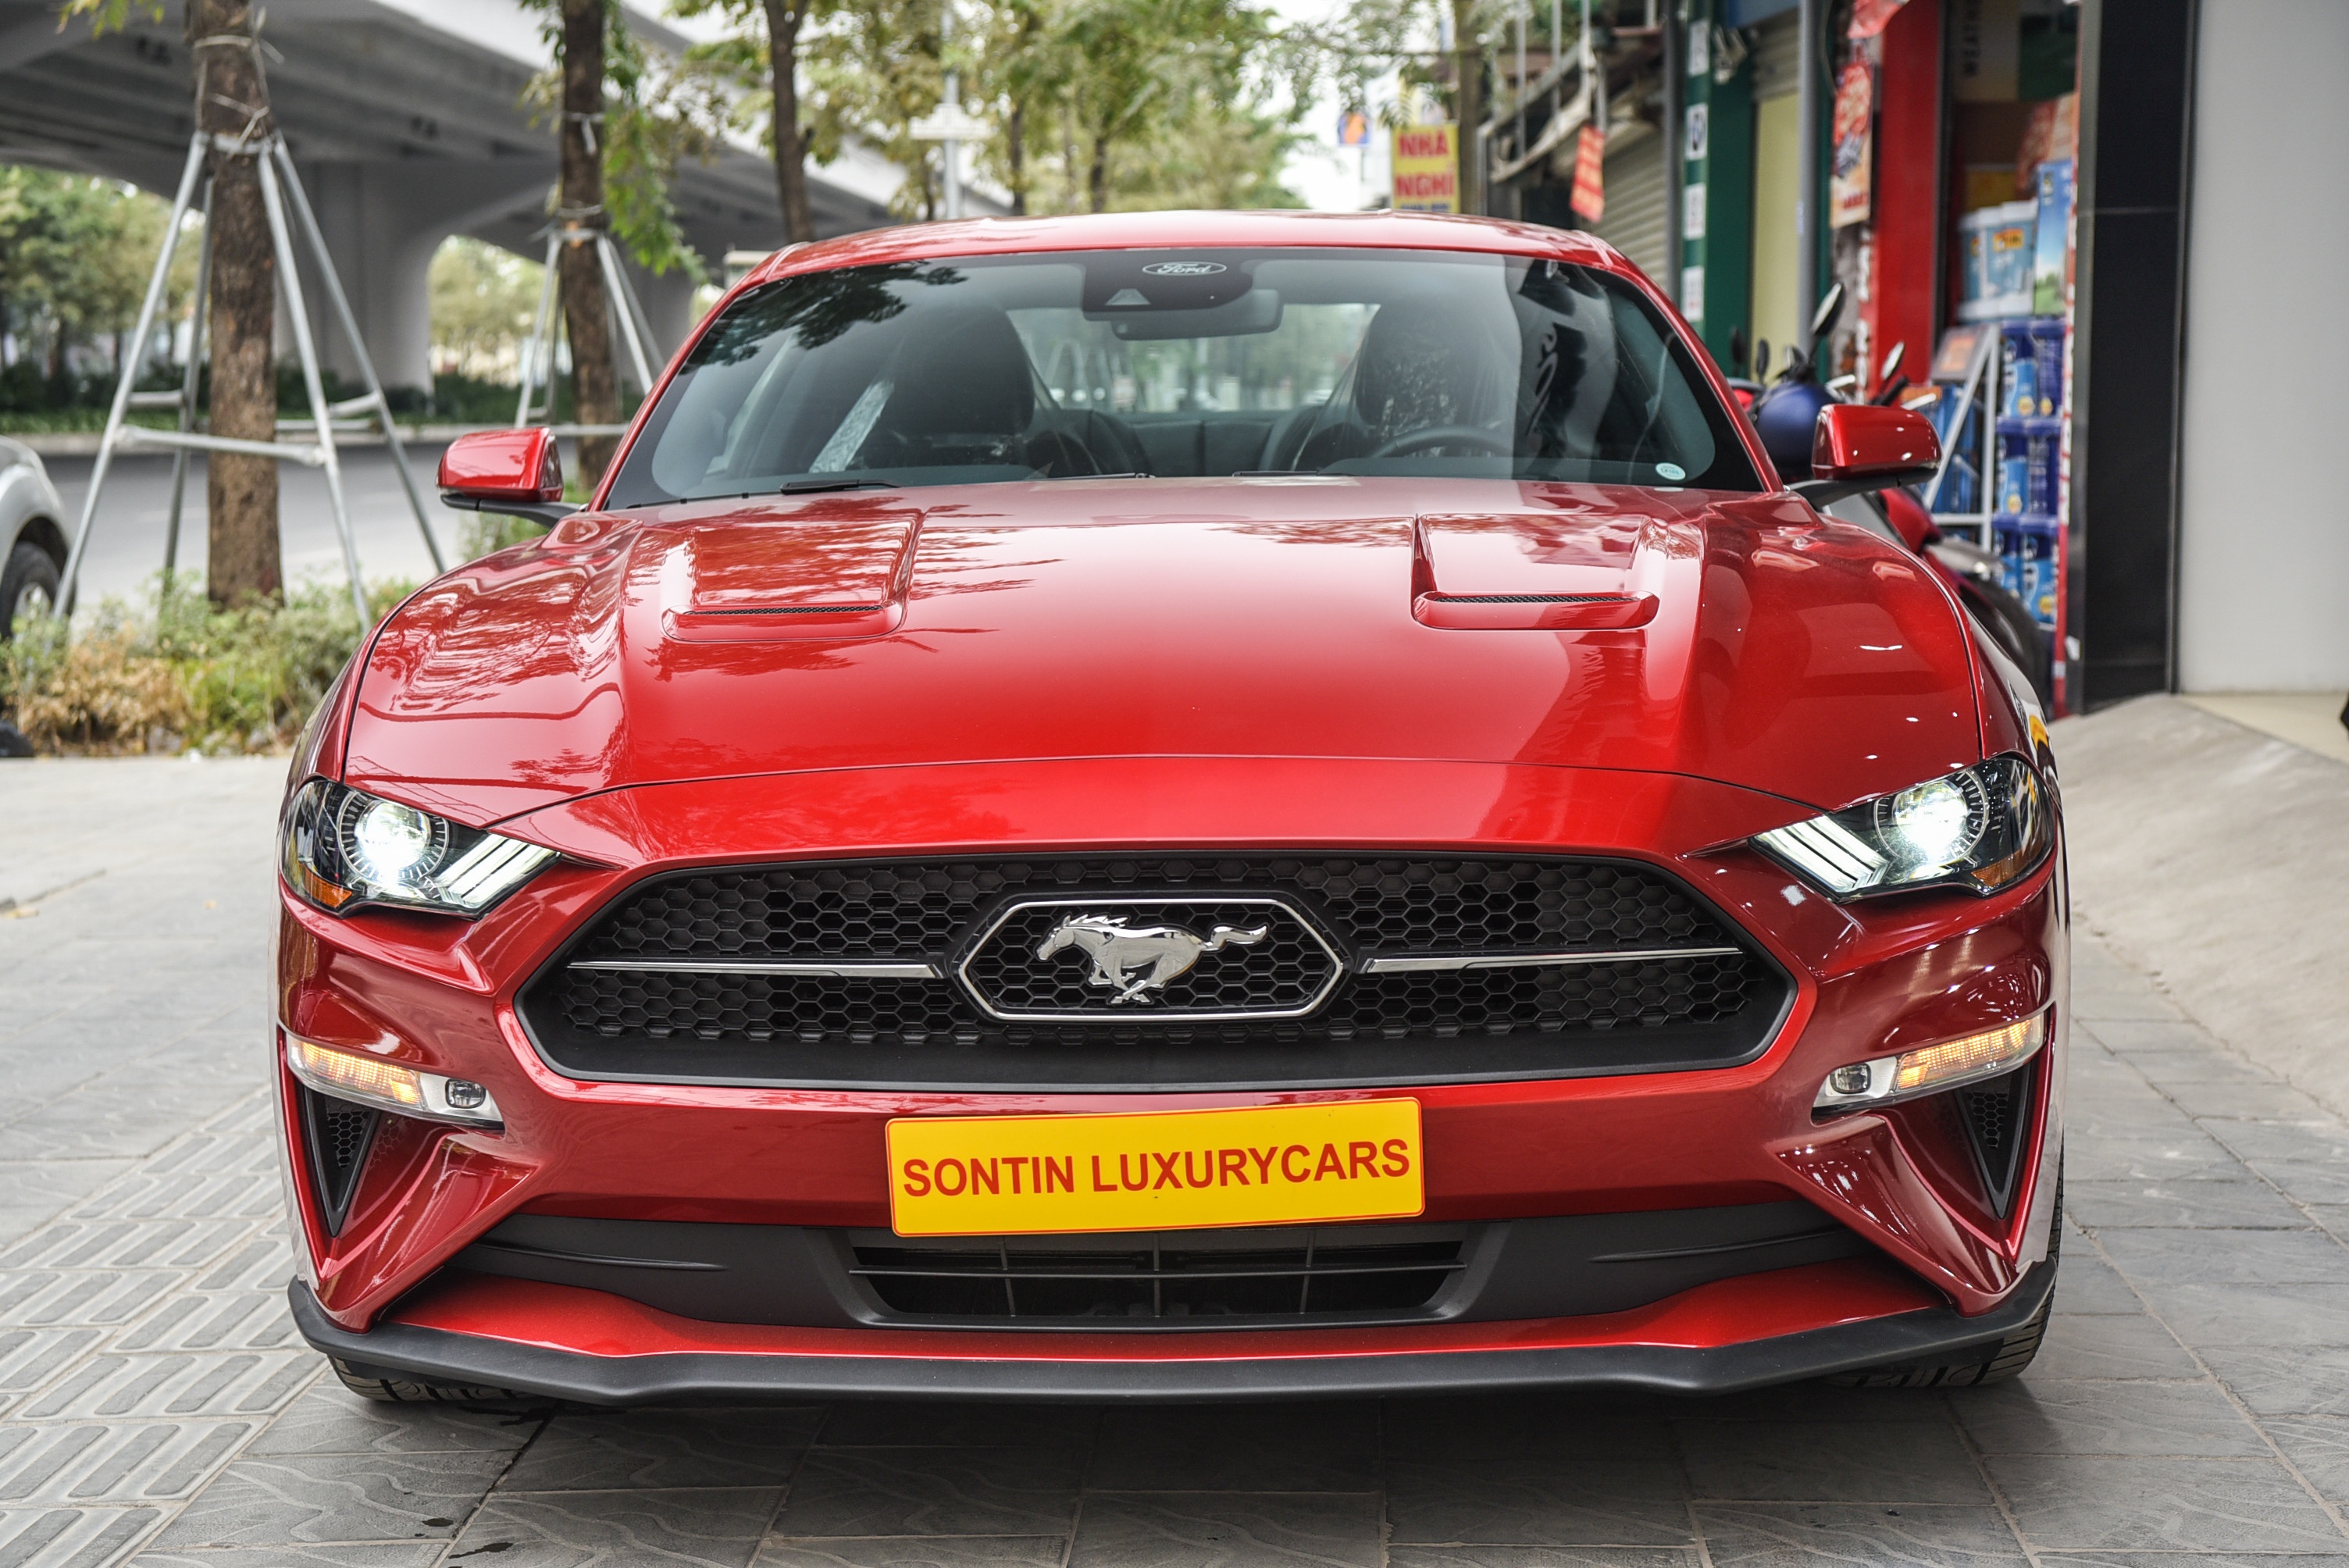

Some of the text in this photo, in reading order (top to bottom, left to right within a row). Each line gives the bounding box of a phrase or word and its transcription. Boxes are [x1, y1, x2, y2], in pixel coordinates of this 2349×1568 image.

[1157, 262, 1212, 274] Ford
[904, 1139, 1410, 1197] SONTIN LUXURYCARS
